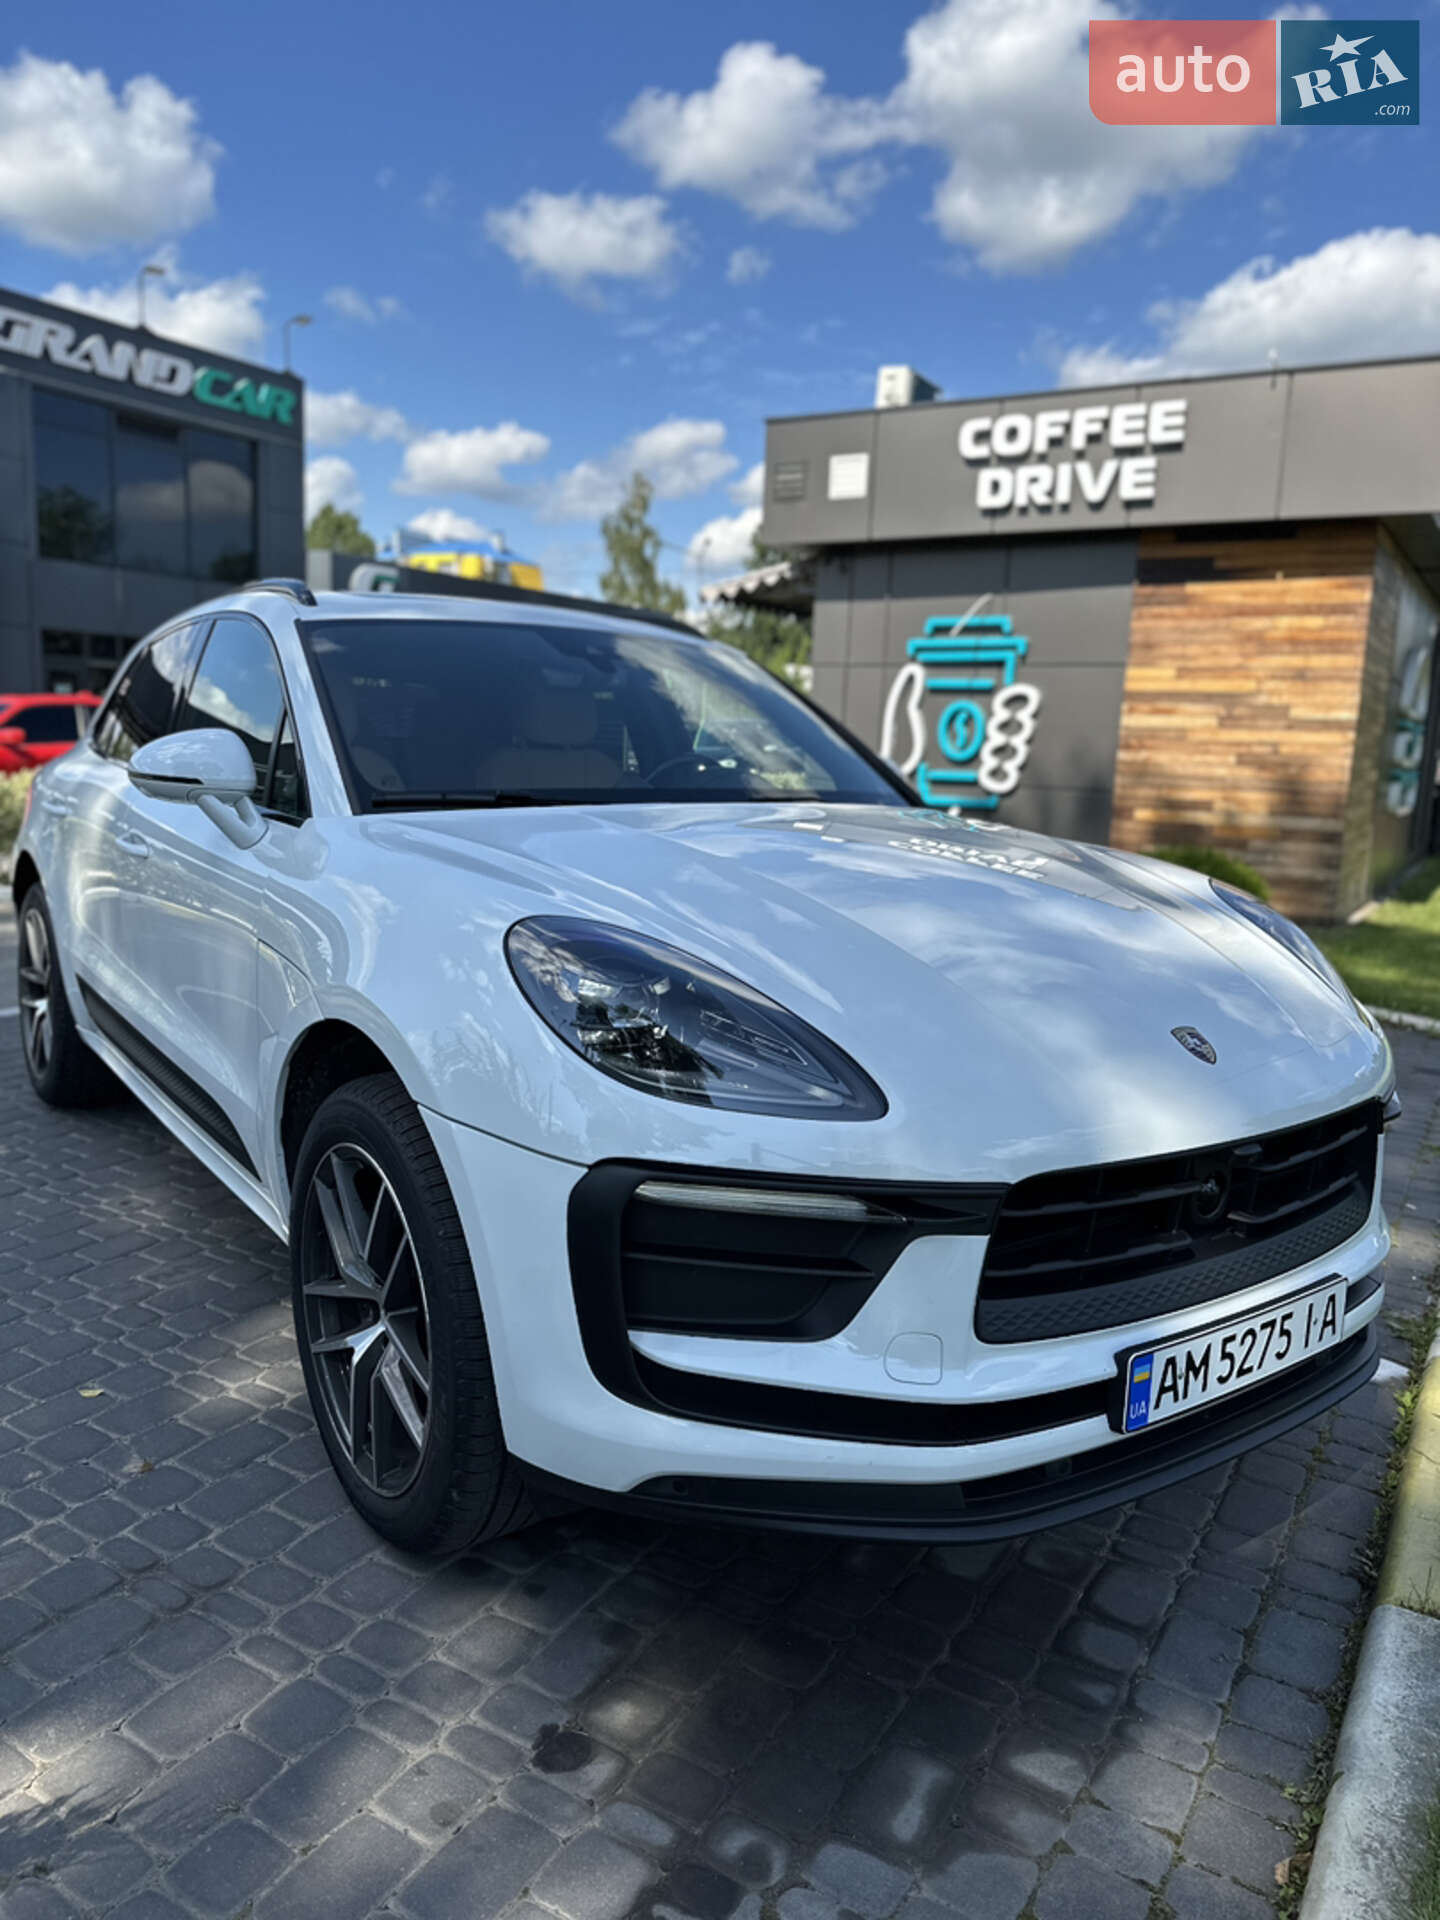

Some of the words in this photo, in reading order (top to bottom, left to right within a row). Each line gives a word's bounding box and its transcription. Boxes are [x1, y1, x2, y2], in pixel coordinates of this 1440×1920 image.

[957, 398, 1188, 460] COFFEE
[976, 456, 1158, 509] DRIVE
[1153, 1342, 1212, 1410] AM
[1216, 1311, 1294, 1385] 5275
[1303, 1292, 1337, 1349] IA
[1129, 1400, 1147, 1419] UA
